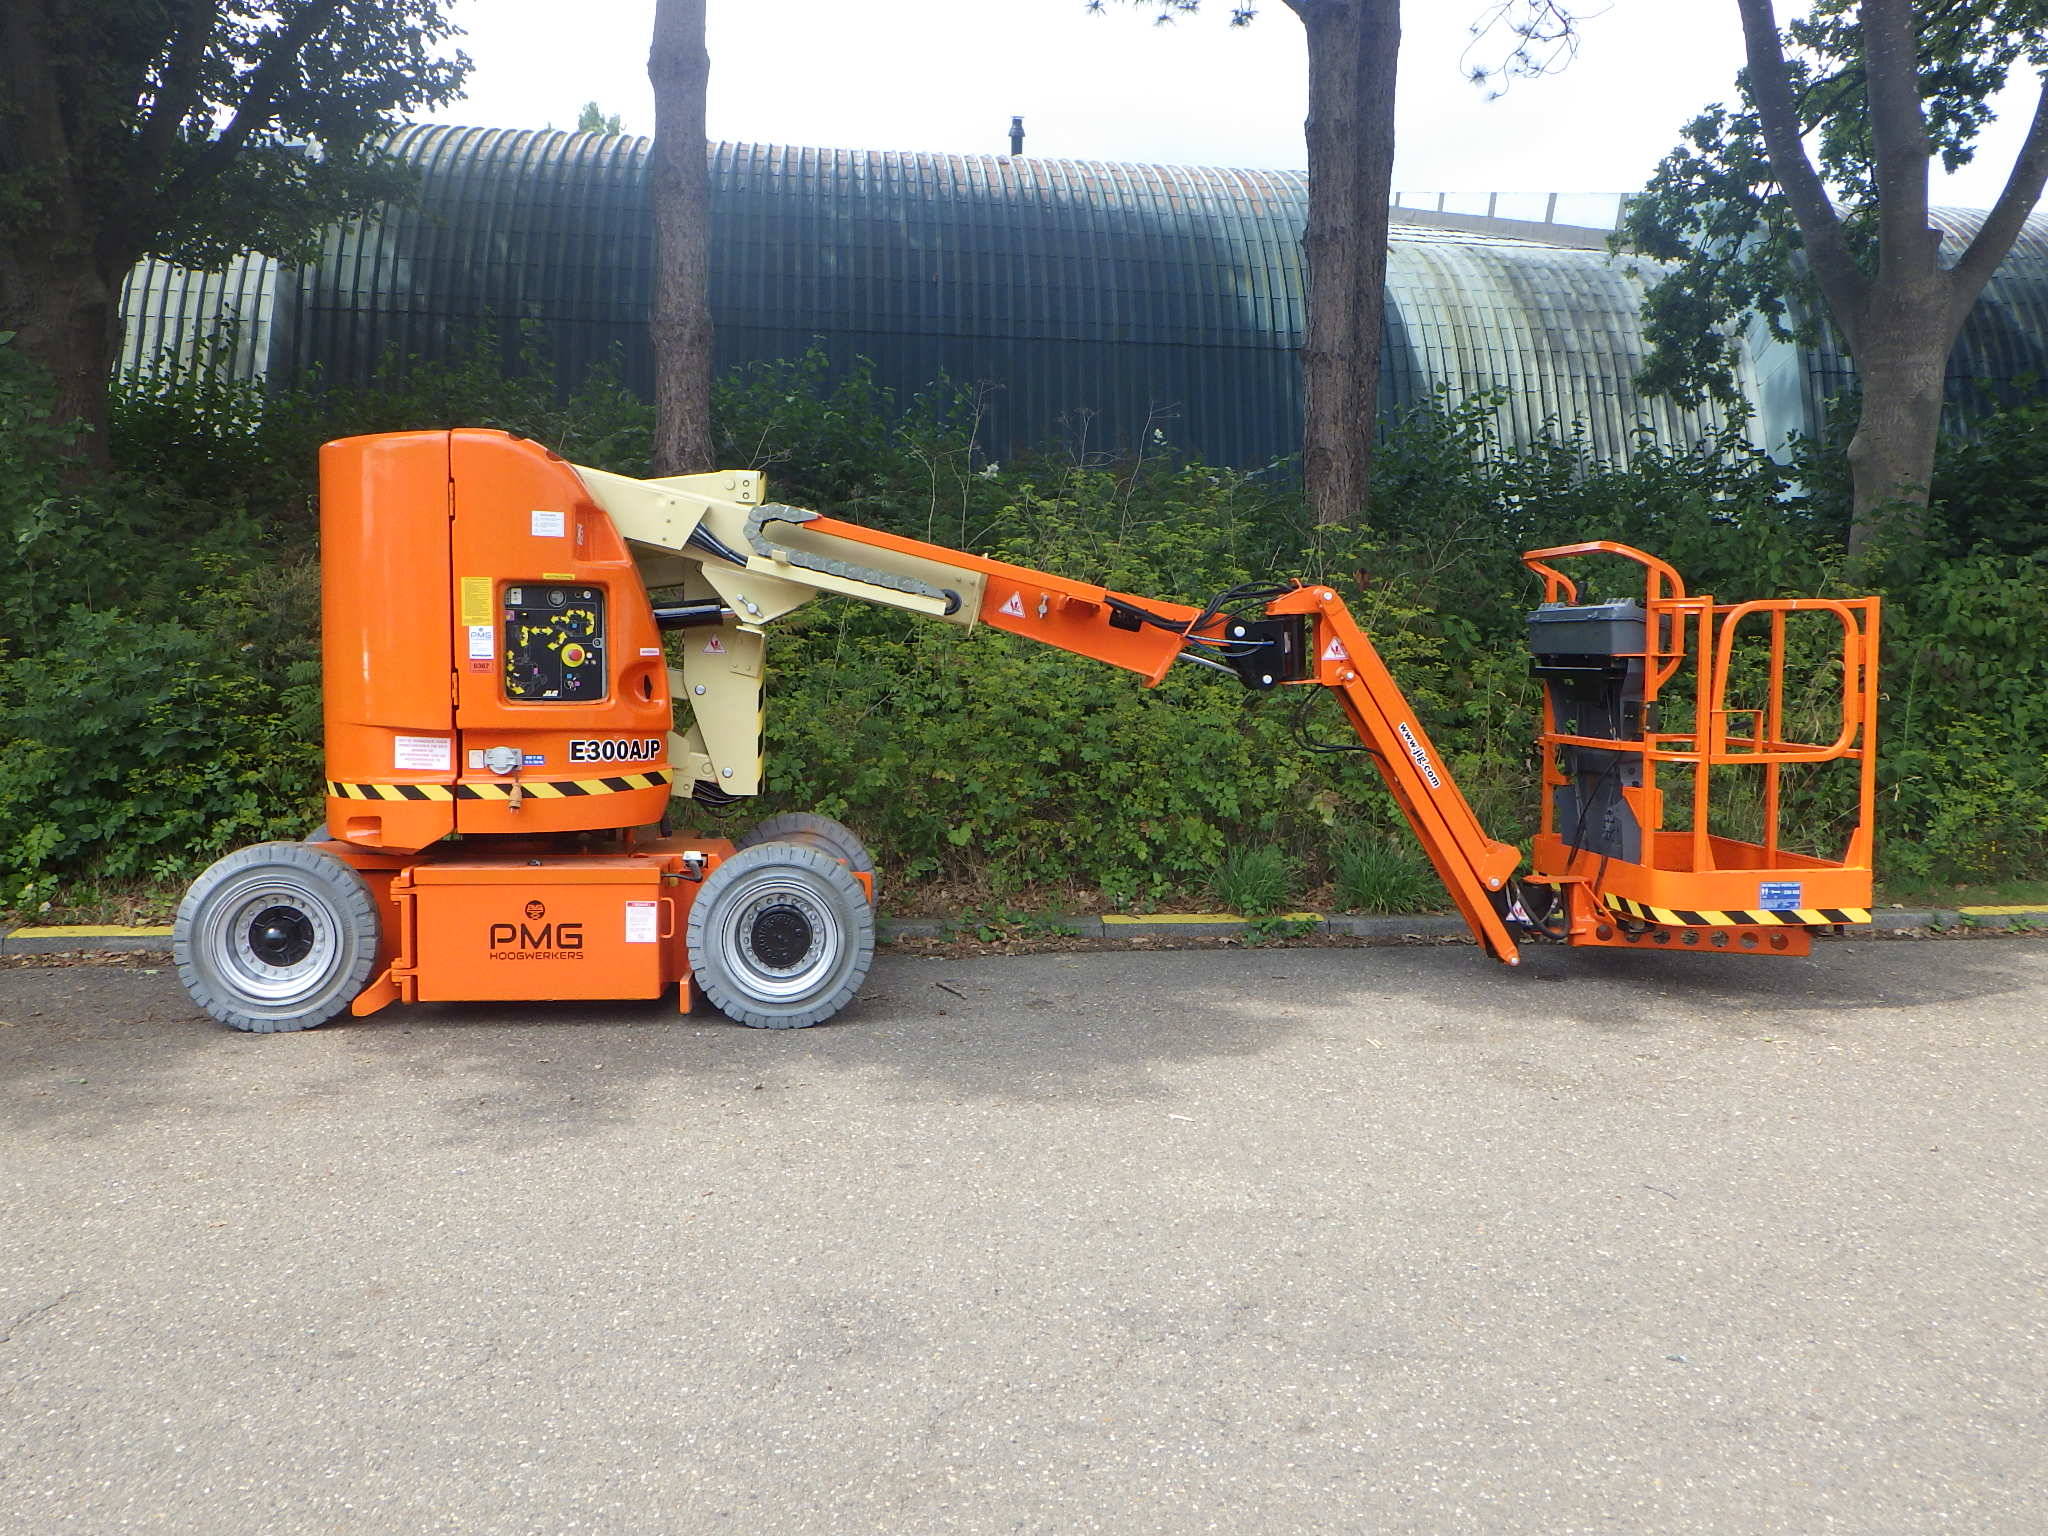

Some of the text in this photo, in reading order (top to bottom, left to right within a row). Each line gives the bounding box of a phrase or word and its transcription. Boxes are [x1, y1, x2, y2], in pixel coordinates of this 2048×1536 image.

[569, 739, 661, 763] E300AJP
[1399, 722, 1440, 787] www.jlg.com
[489, 923, 583, 950] PMG
[489, 951, 584, 960] HOOGWERKERS
